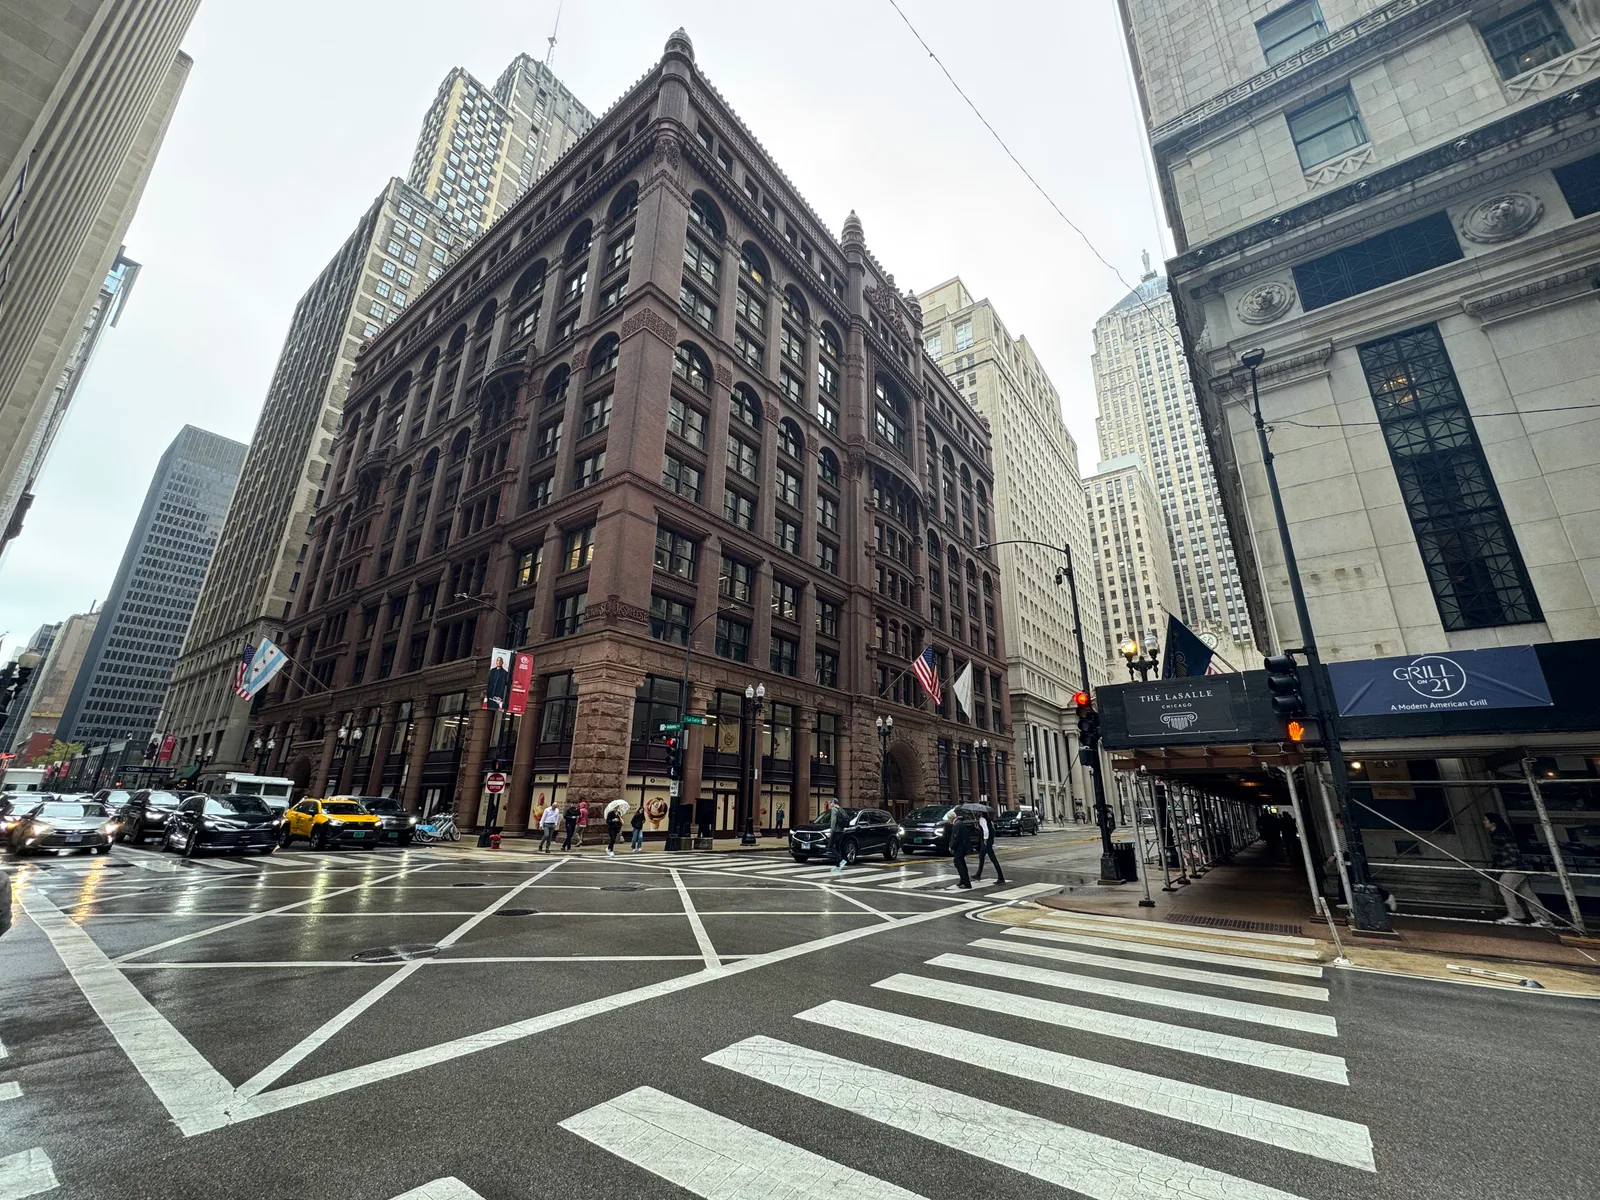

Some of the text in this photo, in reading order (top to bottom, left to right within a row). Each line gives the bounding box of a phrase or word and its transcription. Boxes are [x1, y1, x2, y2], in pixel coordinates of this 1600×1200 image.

[1393, 664, 1455, 681] GRILL
[1429, 678, 1451, 692] 21
[1398, 702, 1428, 710] Modern
[1430, 700, 1468, 709] American
[1469, 699, 1488, 707] Grill
